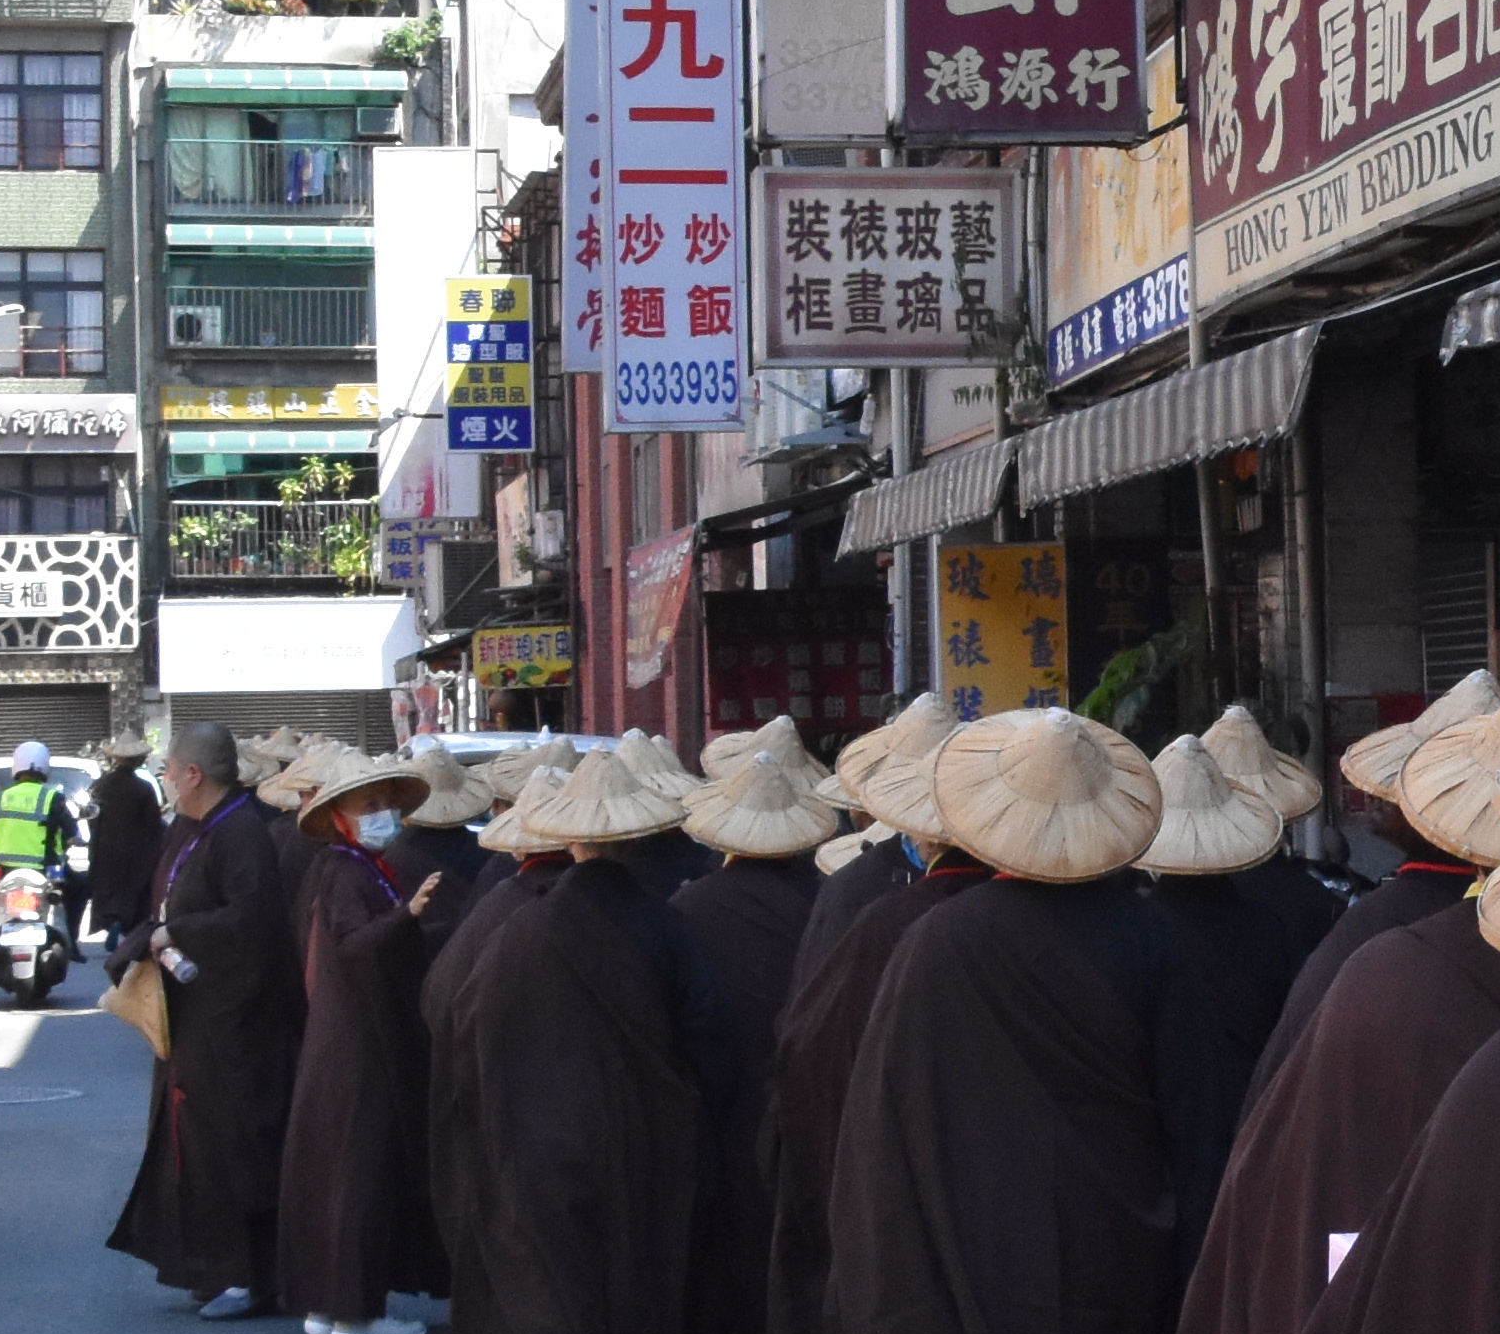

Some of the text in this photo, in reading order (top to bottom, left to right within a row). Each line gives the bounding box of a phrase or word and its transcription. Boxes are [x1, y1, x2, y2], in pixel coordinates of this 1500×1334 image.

[923, 46, 1131, 111] 鴻源行
[1224, 100, 1496, 276] HONG YEW BEDDING
[459, 289, 516, 314] 春聯
[618, 360, 738, 406] 3333935
[460, 416, 519, 442] 煙火
